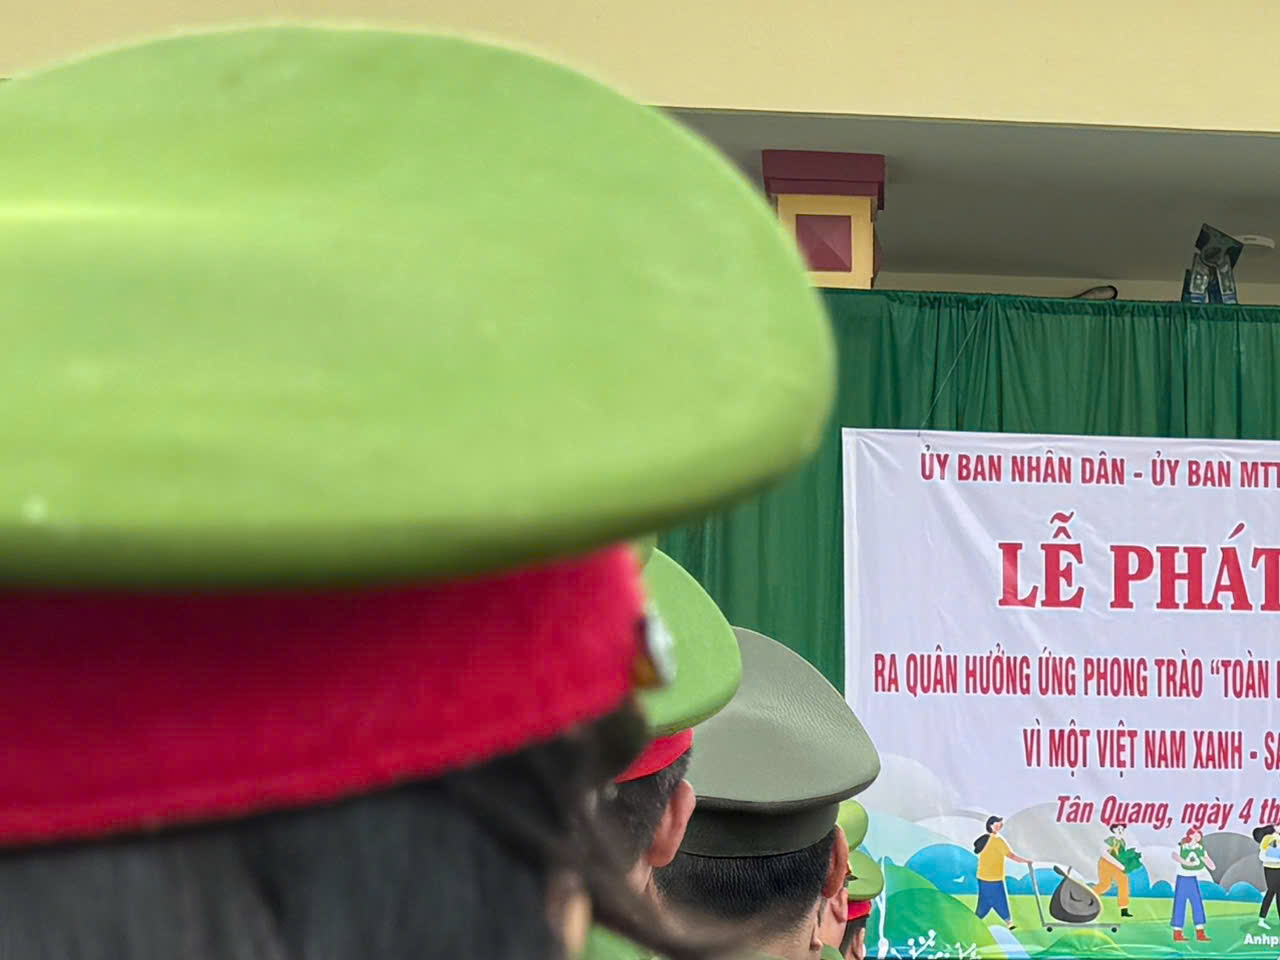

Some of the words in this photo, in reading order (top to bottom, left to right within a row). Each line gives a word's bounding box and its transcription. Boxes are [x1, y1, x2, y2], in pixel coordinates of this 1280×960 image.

[920, 444, 950, 481] ỦY
[957, 454, 1002, 482] BAN
[1011, 449, 1072, 484] NHÂN
[1081, 450, 1125, 485] DÂN
[1151, 450, 1180, 486] ỦY
[1187, 460, 1231, 488] BAN
[998, 511, 1085, 609] LỄ
[874, 653, 900, 693] RA
[905, 644, 958, 698] QUÂN
[965, 642, 1031, 696] HƯỞNG
[1038, 646, 1076, 696] ỨNG
[1083, 657, 1148, 697] PHONG
[1154, 649, 1203, 699] TRÀO
[1210, 649, 1269, 699] “TOÀN
[1022, 718, 1041, 768] VÌ
[1048, 718, 1091, 778] MỘT
[1096, 719, 1138, 778] VIỆT
[1144, 730, 1186, 769] NAM
[1193, 730, 1243, 770] XANH
[1056, 795, 1094, 823] Tân
[1100, 795, 1173, 831] Quang,
[1180, 796, 1234, 831] ngày
[1238, 797, 1254, 825] 4
